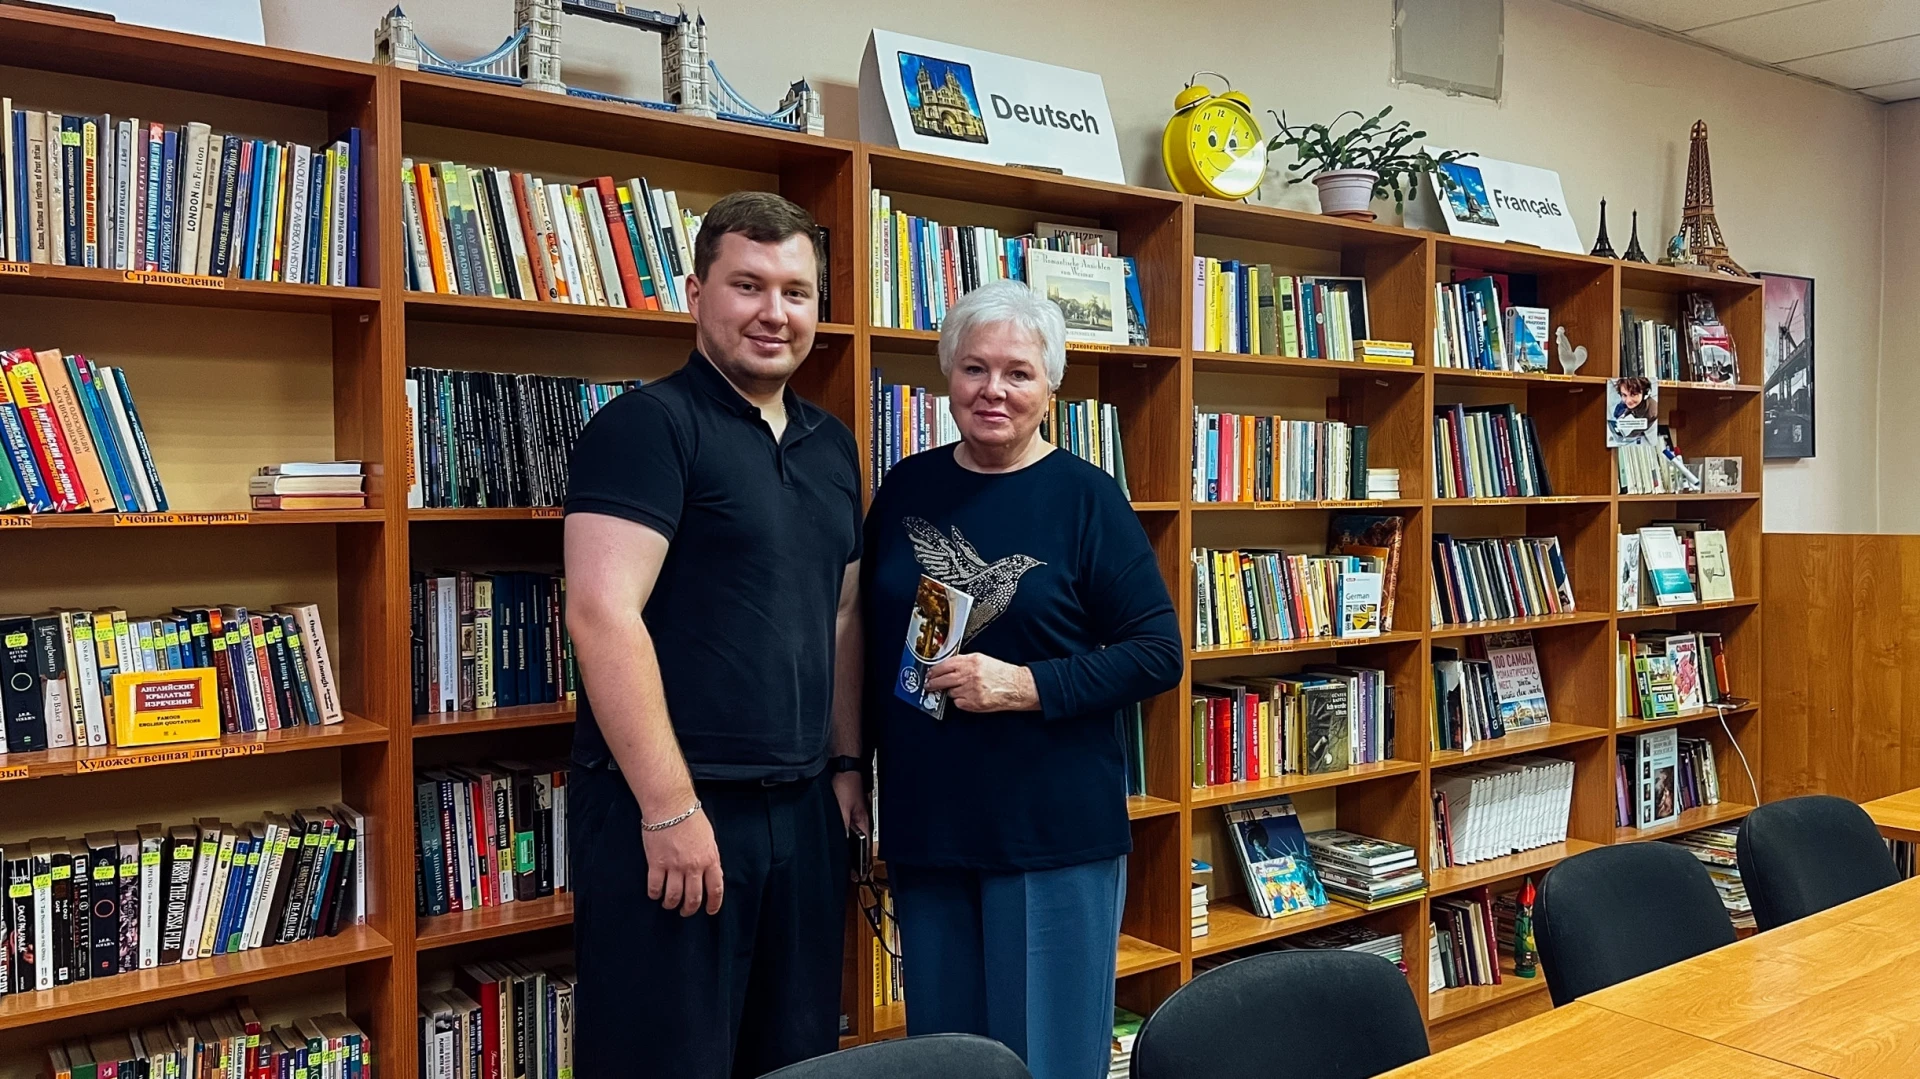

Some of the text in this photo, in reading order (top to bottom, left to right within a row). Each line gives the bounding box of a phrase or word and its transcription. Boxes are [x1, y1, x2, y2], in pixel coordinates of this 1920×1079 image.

[990, 93, 1100, 135] Deutsch
[187, 191, 200, 232] LONDON
[194, 146, 205, 180] Fiction
[1492, 188, 1562, 218] Français
[454, 224, 472, 292] RAY BRADBURY
[466, 228, 487, 294] RAY BRADBURY
[125, 270, 224, 288] Страноведение
[53, 386, 83, 456] ПРАКТИЧЕСКИЙ КУРС
[35, 407, 78, 506] АНГЛИЙСКИЙ ПО-НОВОМУ
[115, 513, 248, 524] Учебные материалы
[1345, 593, 1370, 601] German
[477, 622, 485, 653] ПРИНЦ
[317, 660, 330, 688] Enough
[1506, 652, 1534, 667] САМЫХ
[140, 684, 195, 693] АНГЛИЙСКИЕ
[145, 691, 192, 700] КРЫЛАТЫЕ
[477, 664, 485, 698] НИЩИЙ
[144, 699, 194, 708] ИЗРЕЧЕНИЯ
[78, 743, 264, 772] Художественная литература
[497, 792, 506, 818] TOWN
[433, 853, 444, 902] MIDSHIPMAN
[165, 900, 186, 931] ODESSA
[286, 902, 303, 938] DEADLINE
[163, 930, 181, 951] FILE
